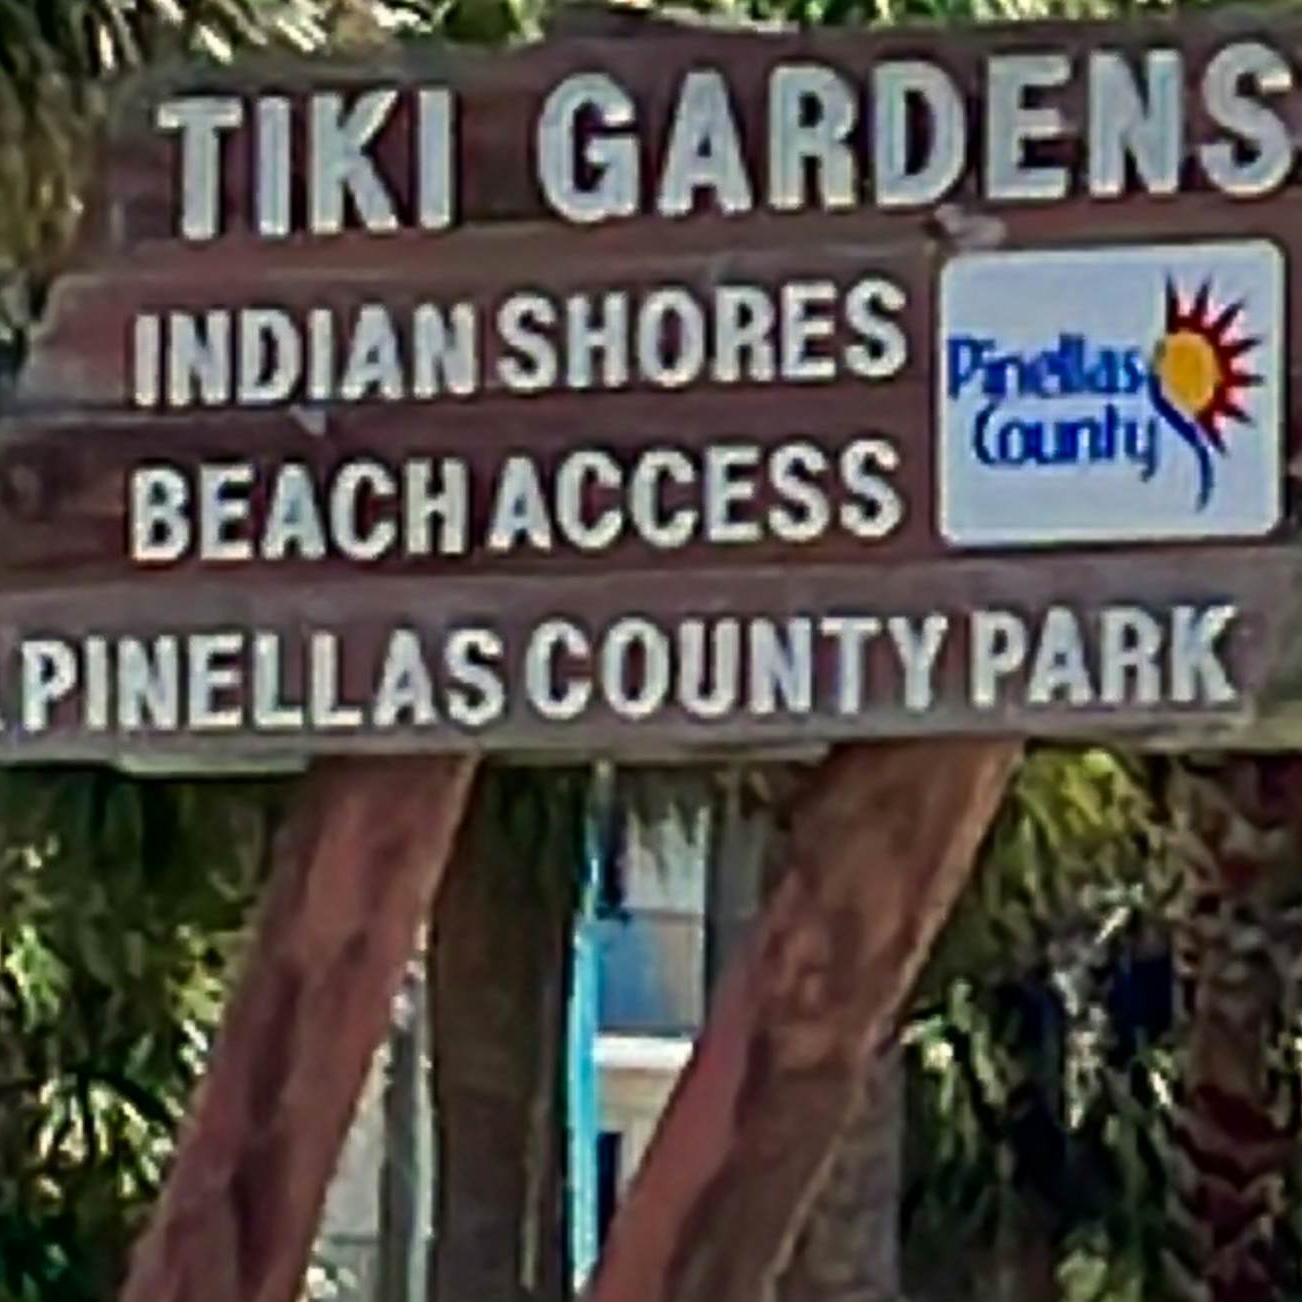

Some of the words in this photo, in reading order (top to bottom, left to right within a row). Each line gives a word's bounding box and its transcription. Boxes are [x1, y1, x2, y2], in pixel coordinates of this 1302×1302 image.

[157, 89, 459, 240] TIKI
[537, 42, 1296, 223] GARDENS
[133, 303, 478, 406] INDIAN
[498, 278, 907, 391] SHORES
[947, 333, 1148, 400] Pinellas
[131, 458, 467, 562] BEACH
[488, 439, 904, 551] ACCESS
[972, 404, 1160, 482] County
[22, 629, 505, 731] PINELLAS
[525, 613, 948, 719] COUNTY
[969, 604, 1237, 707] PARK
